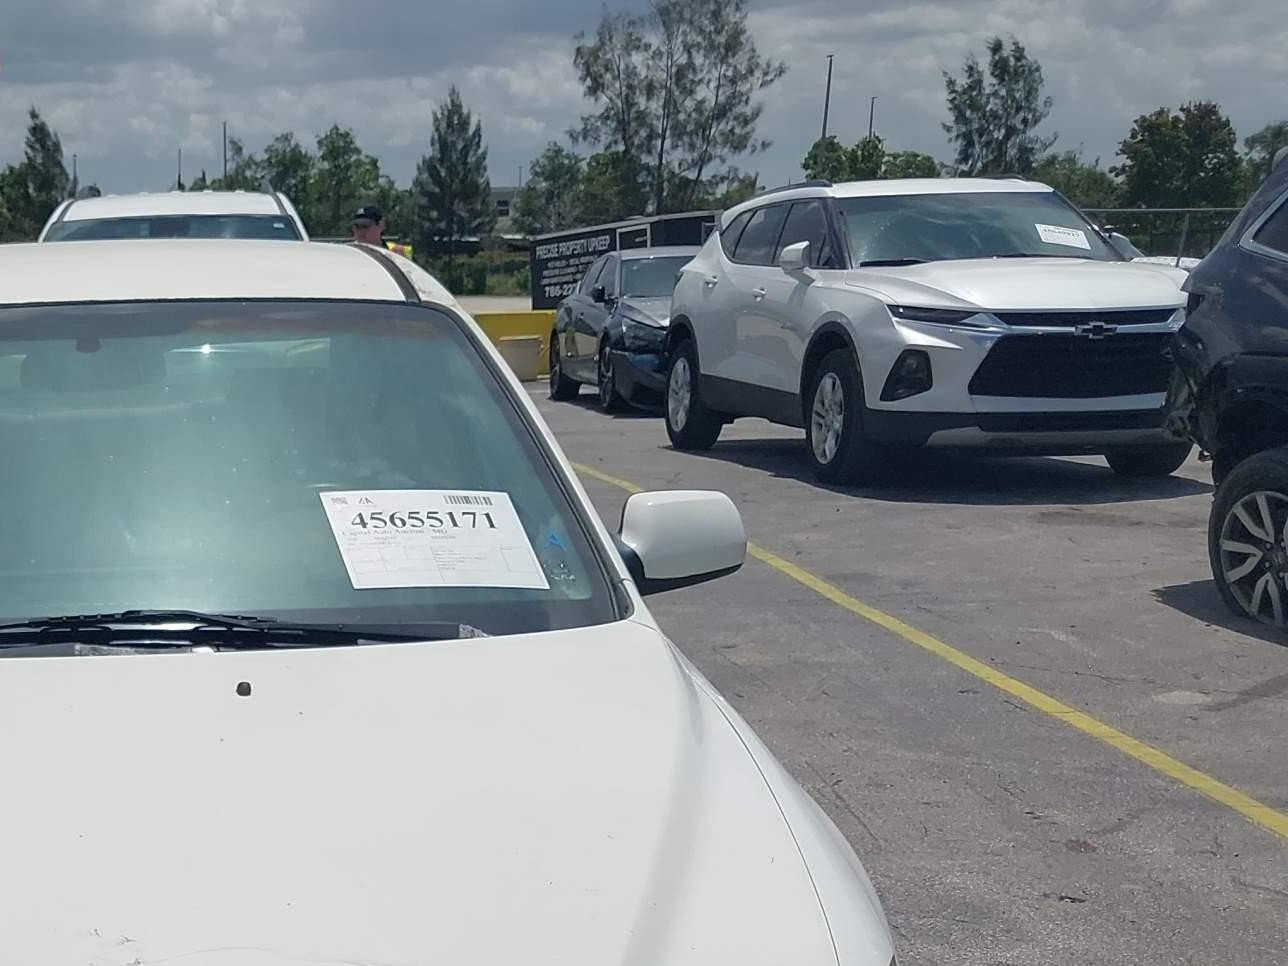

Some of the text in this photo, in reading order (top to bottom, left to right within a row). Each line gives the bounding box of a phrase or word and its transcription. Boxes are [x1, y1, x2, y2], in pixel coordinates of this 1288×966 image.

[559, 239, 588, 256] PROPERTY
[588, 235, 610, 252] UPKEEP
[351, 511, 497, 529] 45655171
